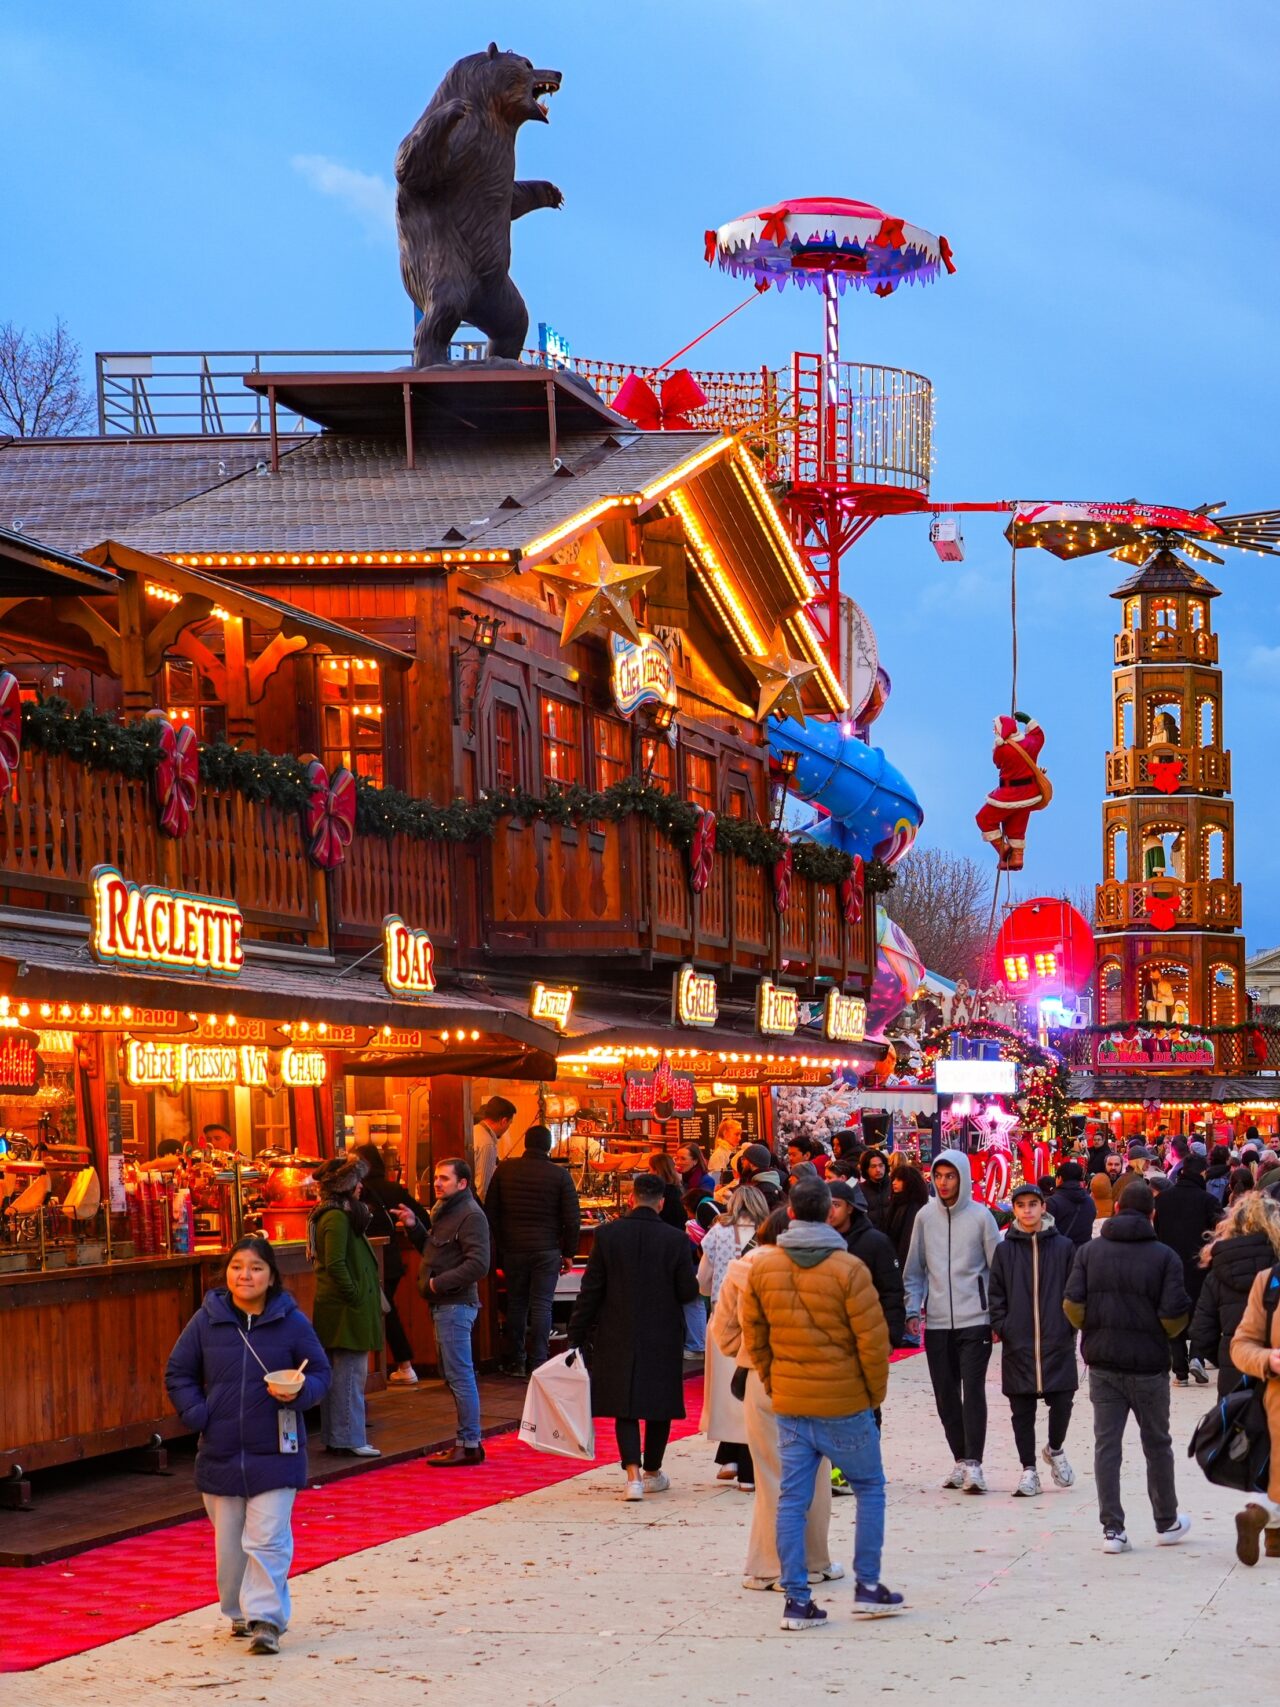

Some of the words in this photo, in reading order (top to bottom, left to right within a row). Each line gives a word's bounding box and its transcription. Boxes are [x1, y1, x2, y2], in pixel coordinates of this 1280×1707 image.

[107, 880, 244, 965] RACLETTE
[396, 927, 436, 986] BAR
[686, 973, 719, 1018] GRILL
[767, 985, 801, 1028] FRITES
[833, 995, 867, 1034] BURGER
[288, 1050, 326, 1082] CHAUD
[1100, 1051, 1120, 1062] LE
[1120, 1051, 1151, 1062] BAR
[1153, 1051, 1173, 1062] DE
